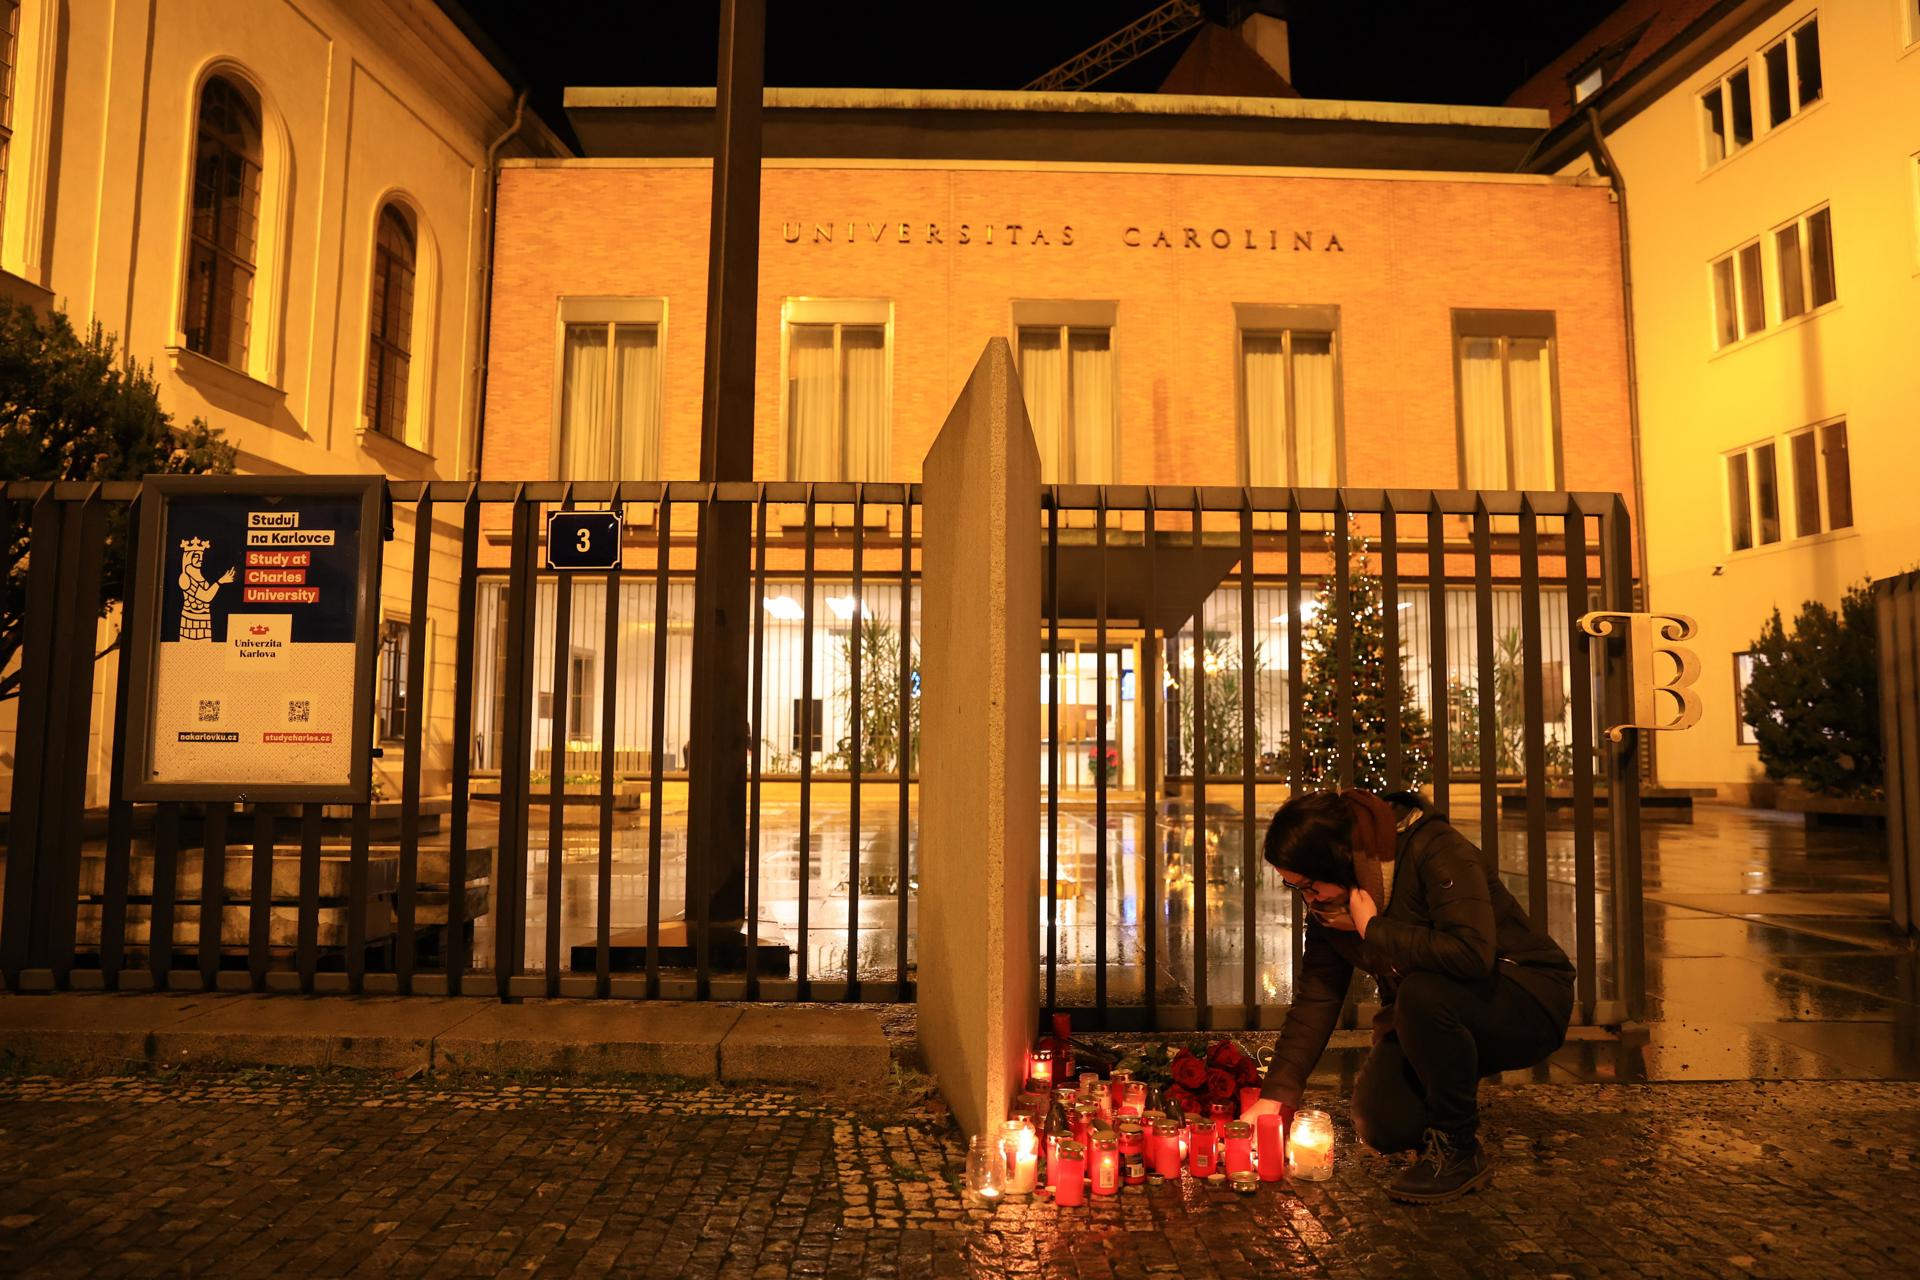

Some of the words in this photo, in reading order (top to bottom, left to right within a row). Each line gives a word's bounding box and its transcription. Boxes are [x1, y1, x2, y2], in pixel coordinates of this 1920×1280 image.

[783, 222, 1074, 246] UNIVERSITAS
[1122, 227, 1344, 252] CAROLINA
[252, 514, 296, 527] Studuj
[251, 534, 268, 544] na
[272, 532, 331, 544] Karlovce
[576, 528, 591, 552] 3
[249, 553, 289, 567] Study
[292, 554, 307, 565] at
[248, 571, 302, 583] Charles
[247, 589, 316, 603] University
[234, 638, 282, 648] Univerzita
[239, 649, 276, 658] Karlova
[179, 732, 238, 742] nakarlovku.cz
[264, 733, 331, 743] studycharles.cz
